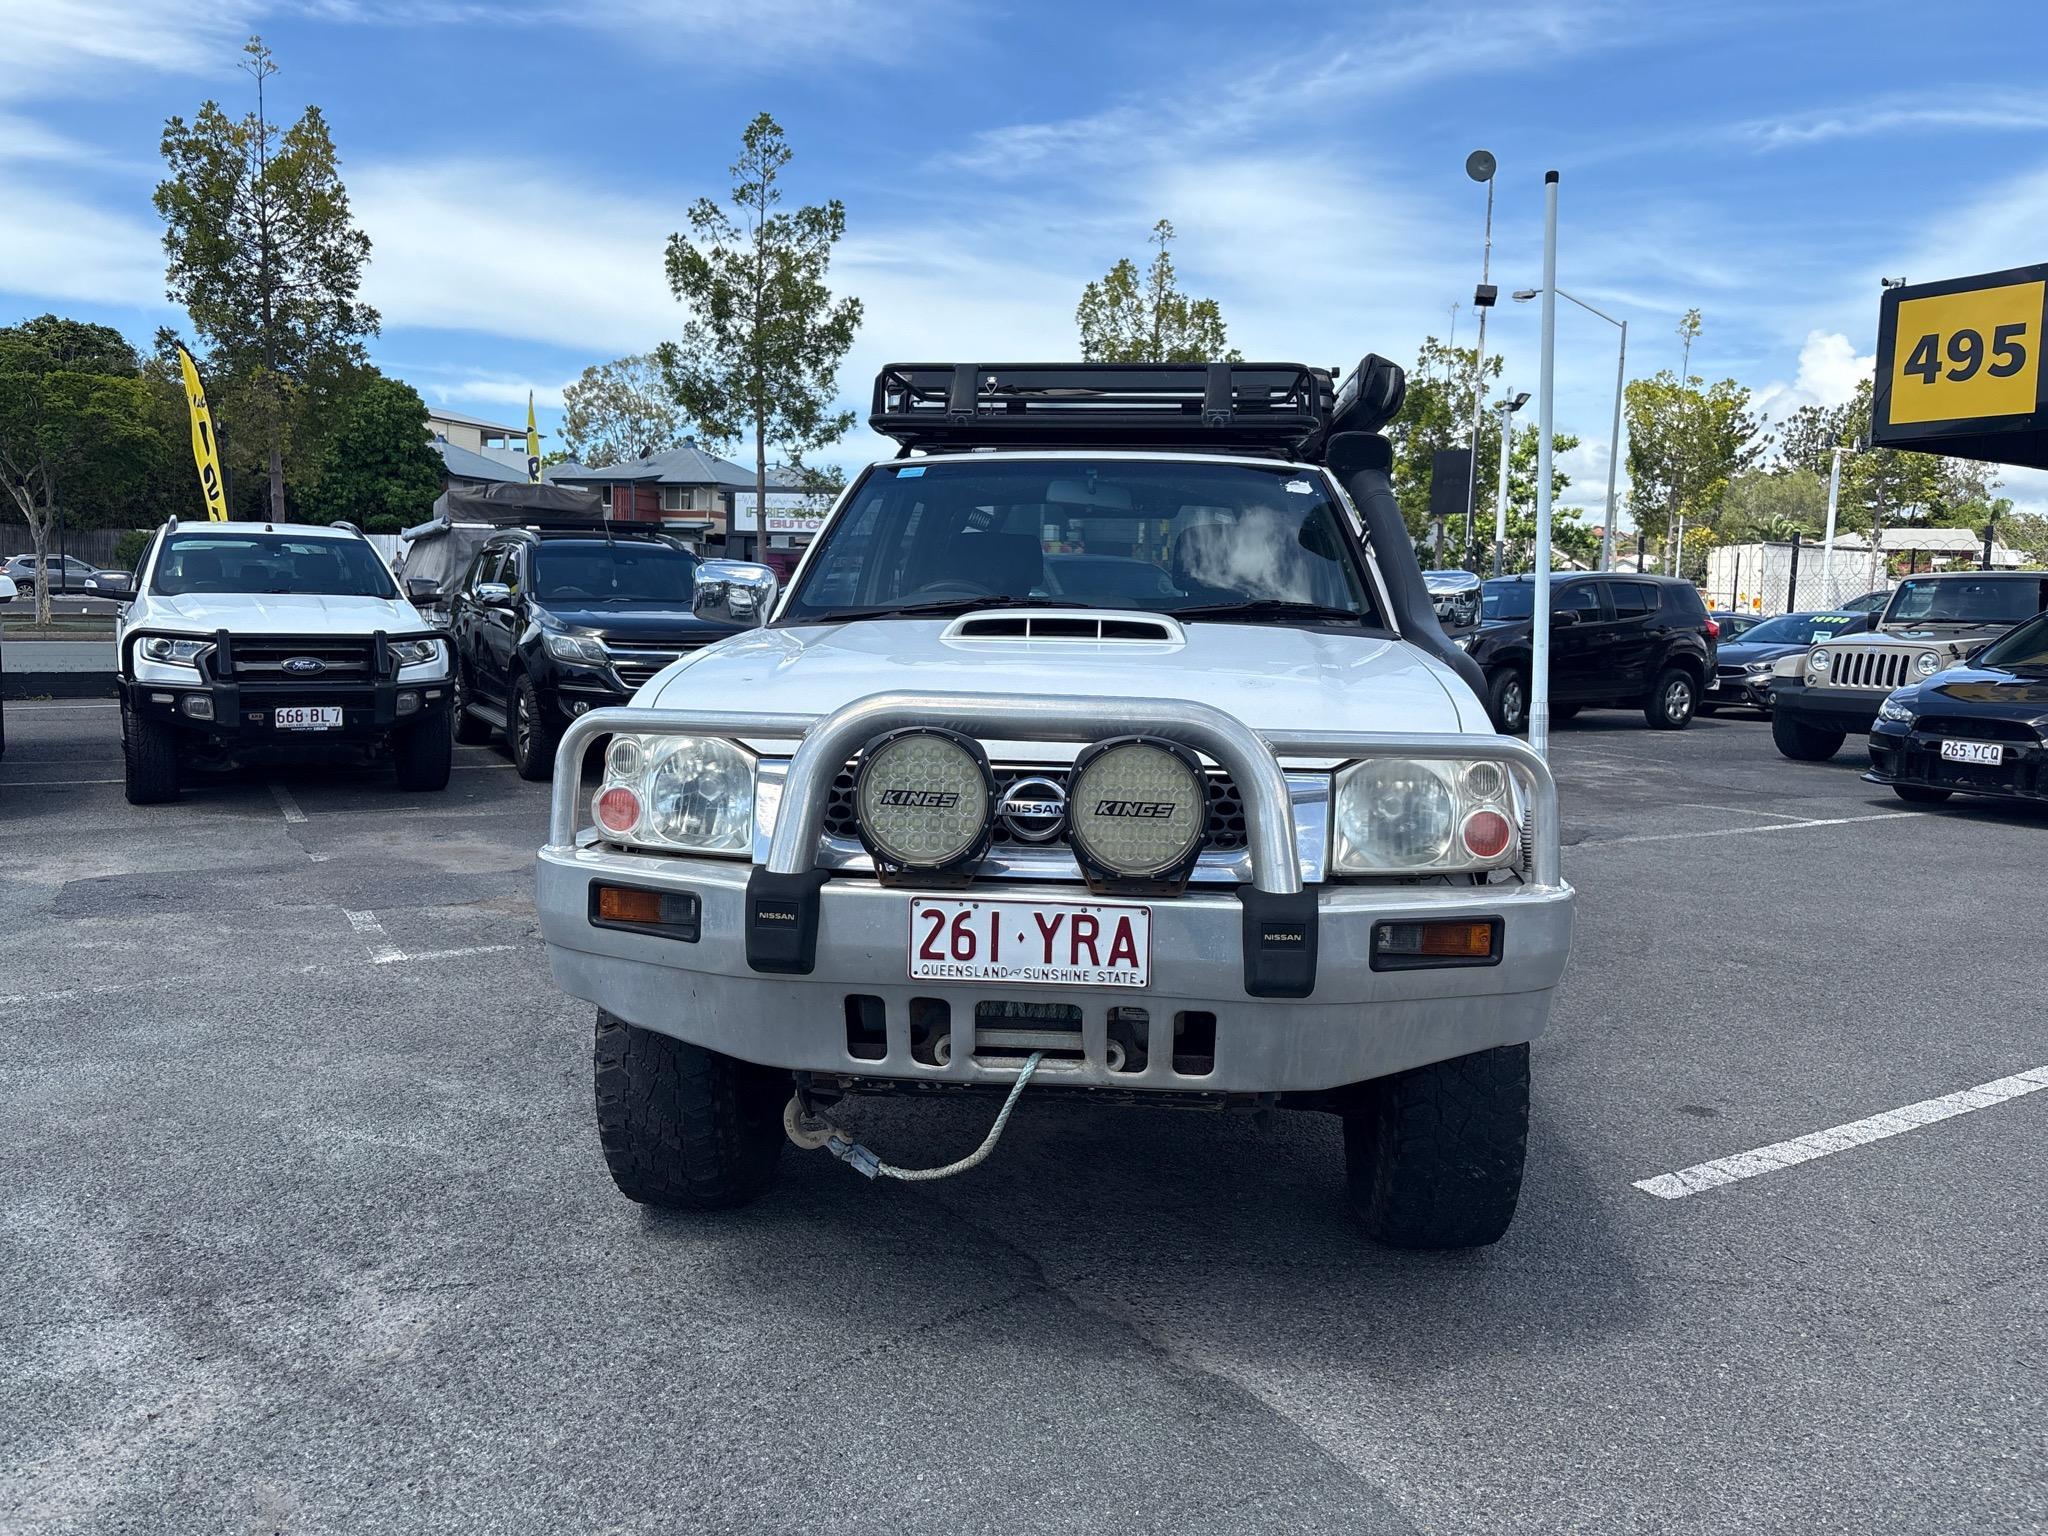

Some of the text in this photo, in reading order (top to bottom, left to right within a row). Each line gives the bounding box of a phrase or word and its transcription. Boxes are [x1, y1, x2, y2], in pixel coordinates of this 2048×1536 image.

[1904, 322, 2027, 384] 495
[292, 660, 316, 670] Ford
[881, 790, 959, 808] KINGS
[1005, 803, 1065, 815] NISSAN
[1095, 800, 1176, 818] KINGS
[759, 912, 795, 920] NISSAN
[921, 963, 1138, 984] QUEENSLAND SUNSHINE STATE
